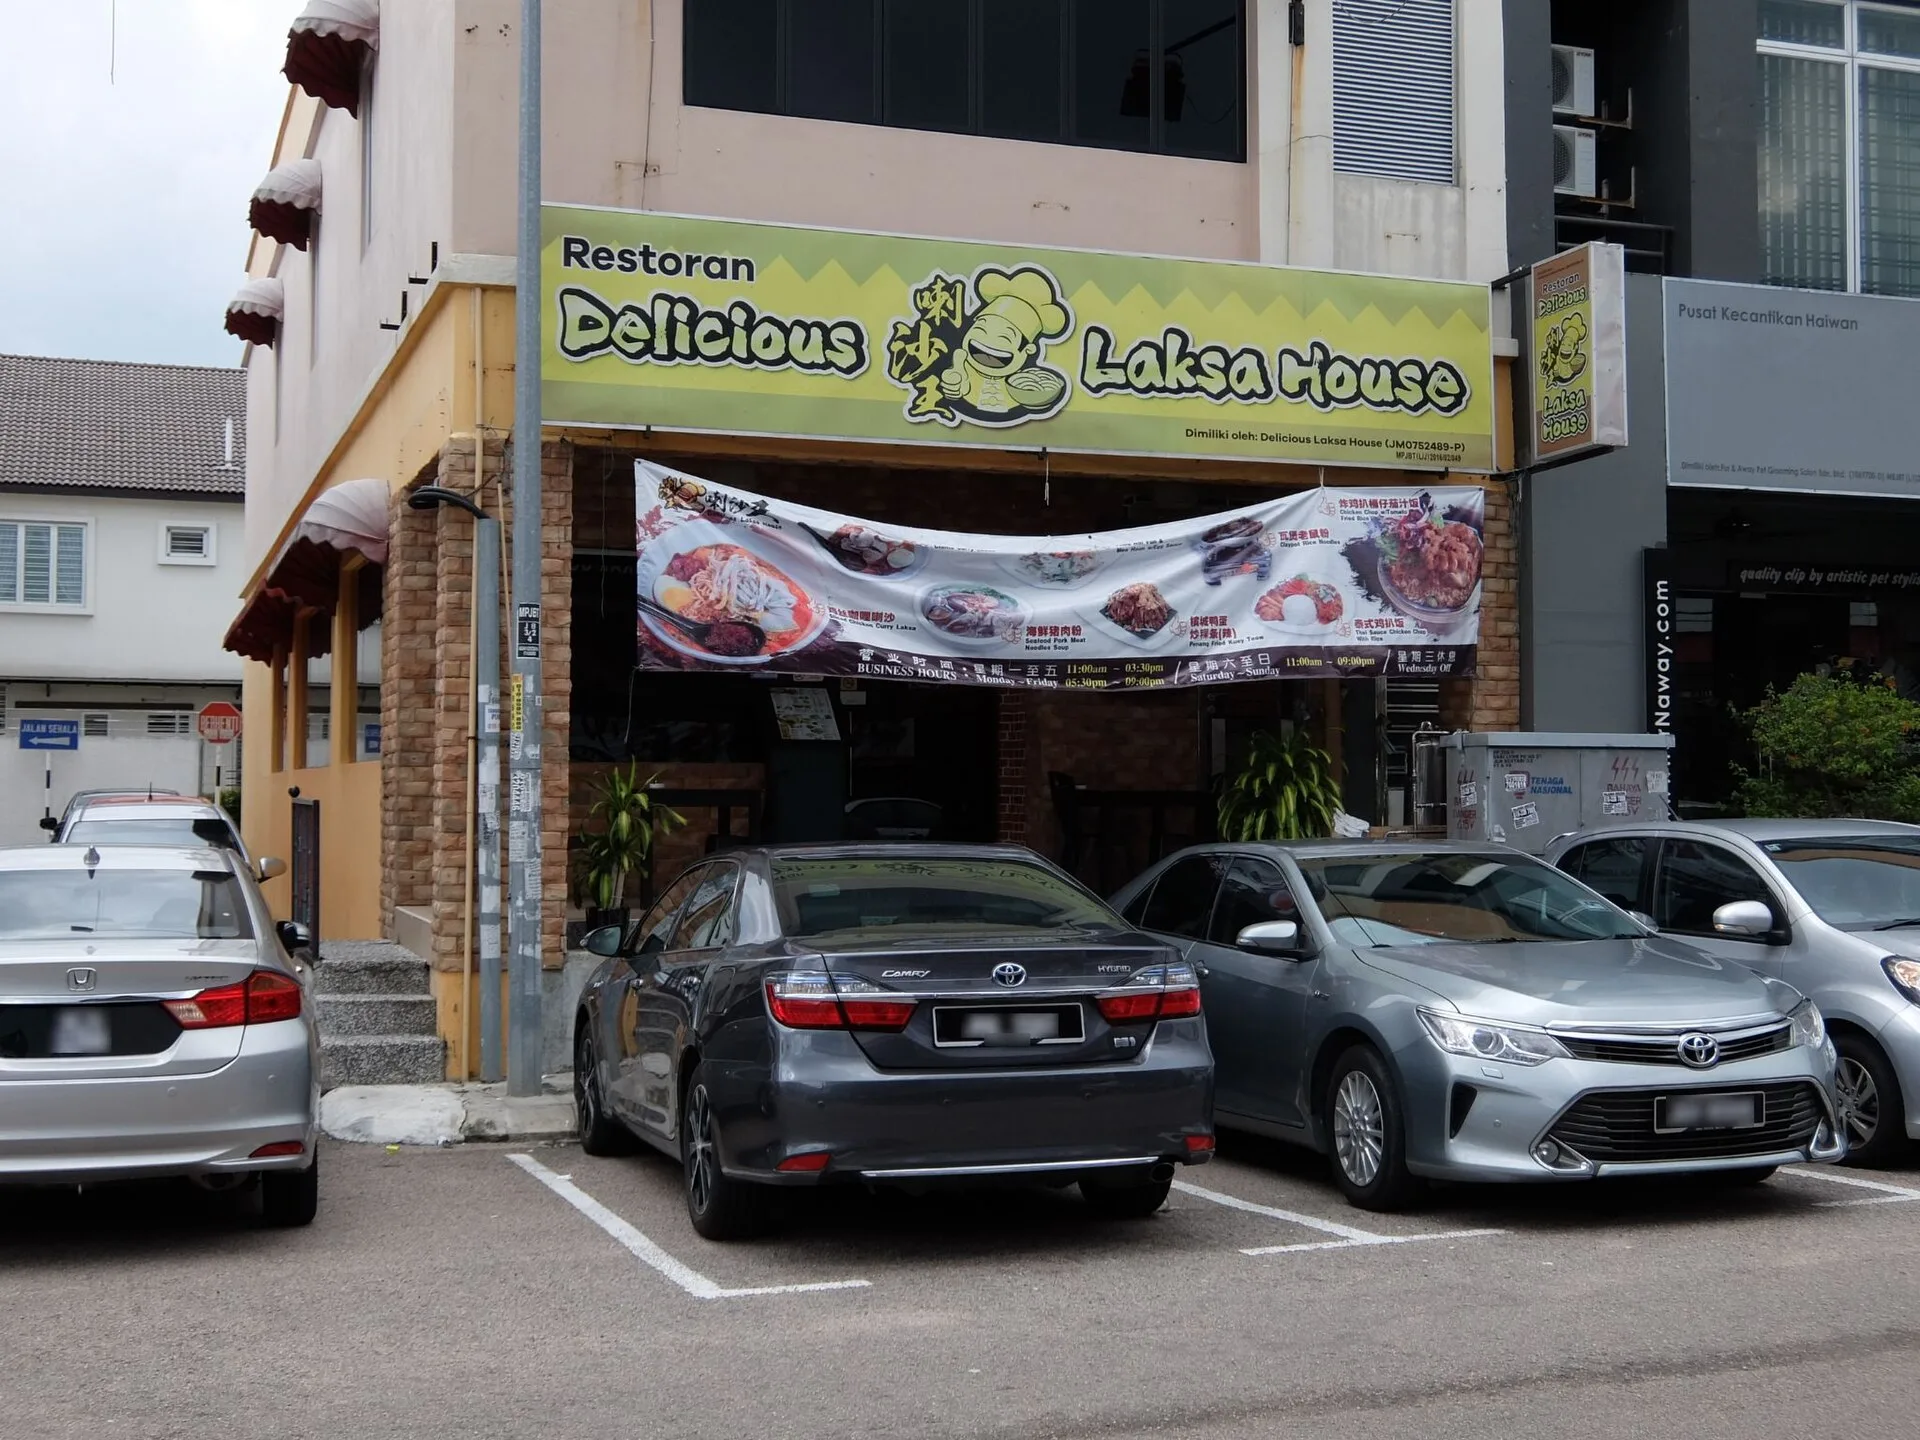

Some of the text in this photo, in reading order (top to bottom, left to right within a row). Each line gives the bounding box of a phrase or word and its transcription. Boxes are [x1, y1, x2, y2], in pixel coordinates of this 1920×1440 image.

[562, 236, 755, 283] Restoran
[1541, 273, 1580, 294] Restoran
[1538, 286, 1587, 317] Delicious
[1678, 303, 1858, 331] Pusat Kecantikan Haiwan
[559, 288, 867, 376] Delicious
[1081, 326, 1468, 413] Laksa House
[1543, 389, 1586, 419] Laksa
[1541, 412, 1588, 442] House
[1185, 428, 1466, 453] Dimiliki oleh: Delicious Laksa House (JM0752489-P)
[1740, 566, 1782, 584] quality
[1784, 567, 1805, 585] clip
[1809, 568, 1824, 586] by
[1827, 569, 1867, 584] artistic
[1869, 571, 1889, 587] pet
[875, 622, 894, 631] Curry
[1188, 653, 1272, 673] 星期六至日
[1286, 656, 1323, 667] 11:00am
[1337, 656, 1375, 667] 09:00pm
[1398, 650, 1456, 663] 星期三休息
[858, 663, 957, 681] BUSINESS HOURS
[974, 663, 1058, 677] 星期一至五
[1066, 664, 1108, 675] 11:00am
[1125, 663, 1164, 675] 03:30pm
[1190, 671, 1236, 683] Saturday
[1246, 666, 1280, 679] Sunday
[1439, 663, 1452, 673] Off
[976, 674, 1016, 686] Monday
[1026, 677, 1059, 689] Friday
[1065, 677, 1108, 688] 05:30pm
[1125, 677, 1165, 687] 09:00pm
[20, 722, 47, 733] JALAN
[1530, 776, 1564, 786] TENAGA
[1529, 785, 1573, 795] NASIONAL
[881, 969, 931, 979] CAMRY
[1097, 965, 1131, 973] HYBRID
